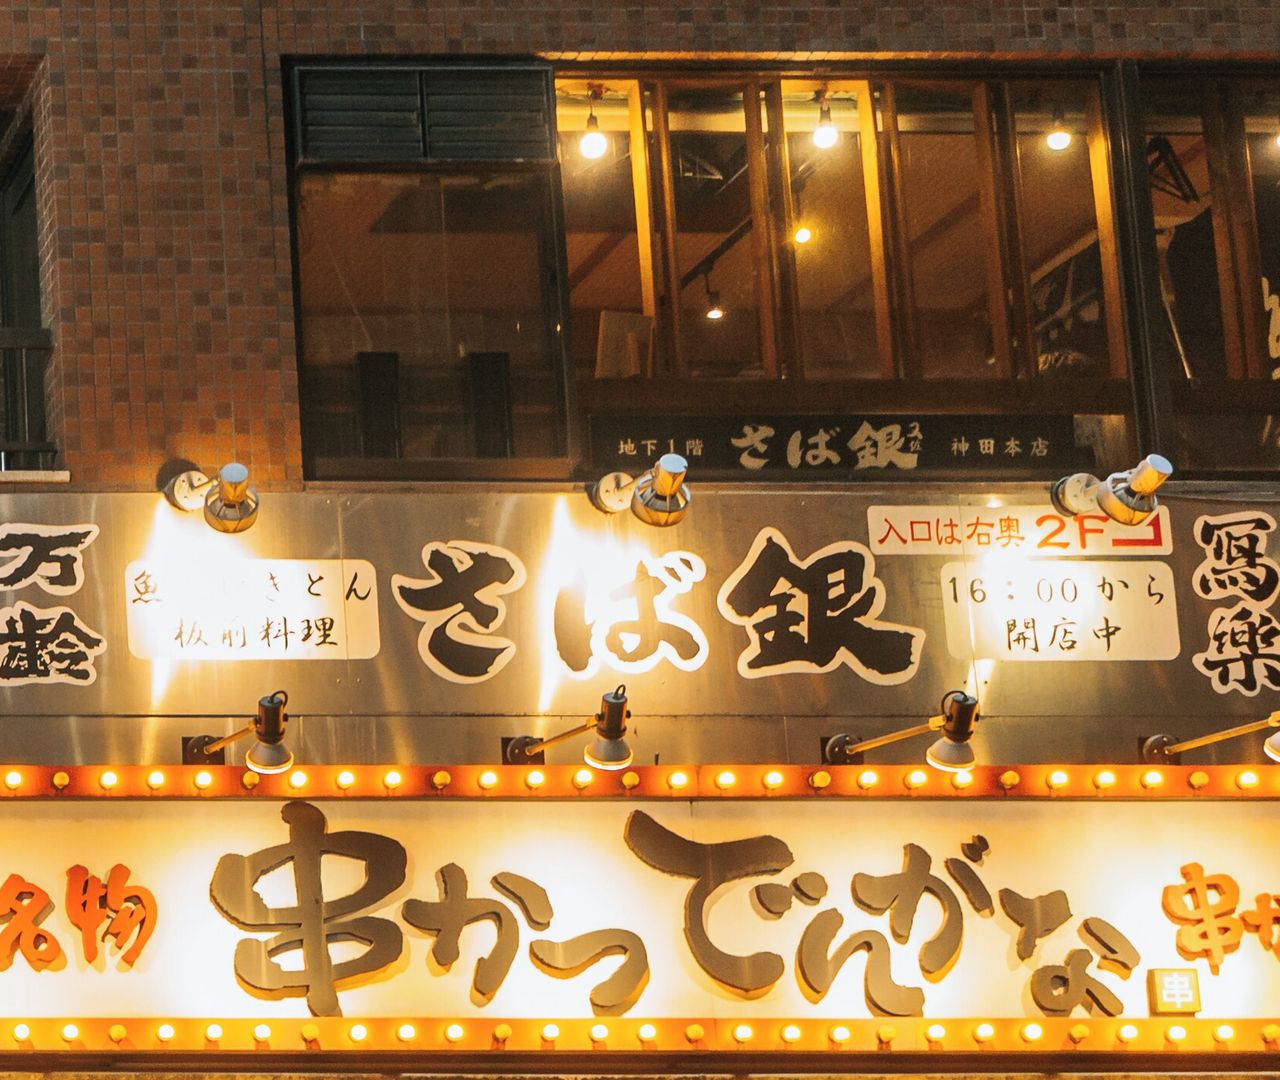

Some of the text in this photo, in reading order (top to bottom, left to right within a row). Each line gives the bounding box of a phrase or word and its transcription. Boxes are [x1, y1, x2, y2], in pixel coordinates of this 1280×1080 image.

[730, 420, 919, 470] さば銀
[951, 436, 1049, 458] 神田本店
[878, 513, 1111, 550] 入口は右奥 2F
[132, 569, 374, 605] 魚きとん
[393, 527, 925, 685] さば銀
[1005, 616, 1123, 654] 開店中
[209, 800, 1141, 1018] 串かつでんがな
